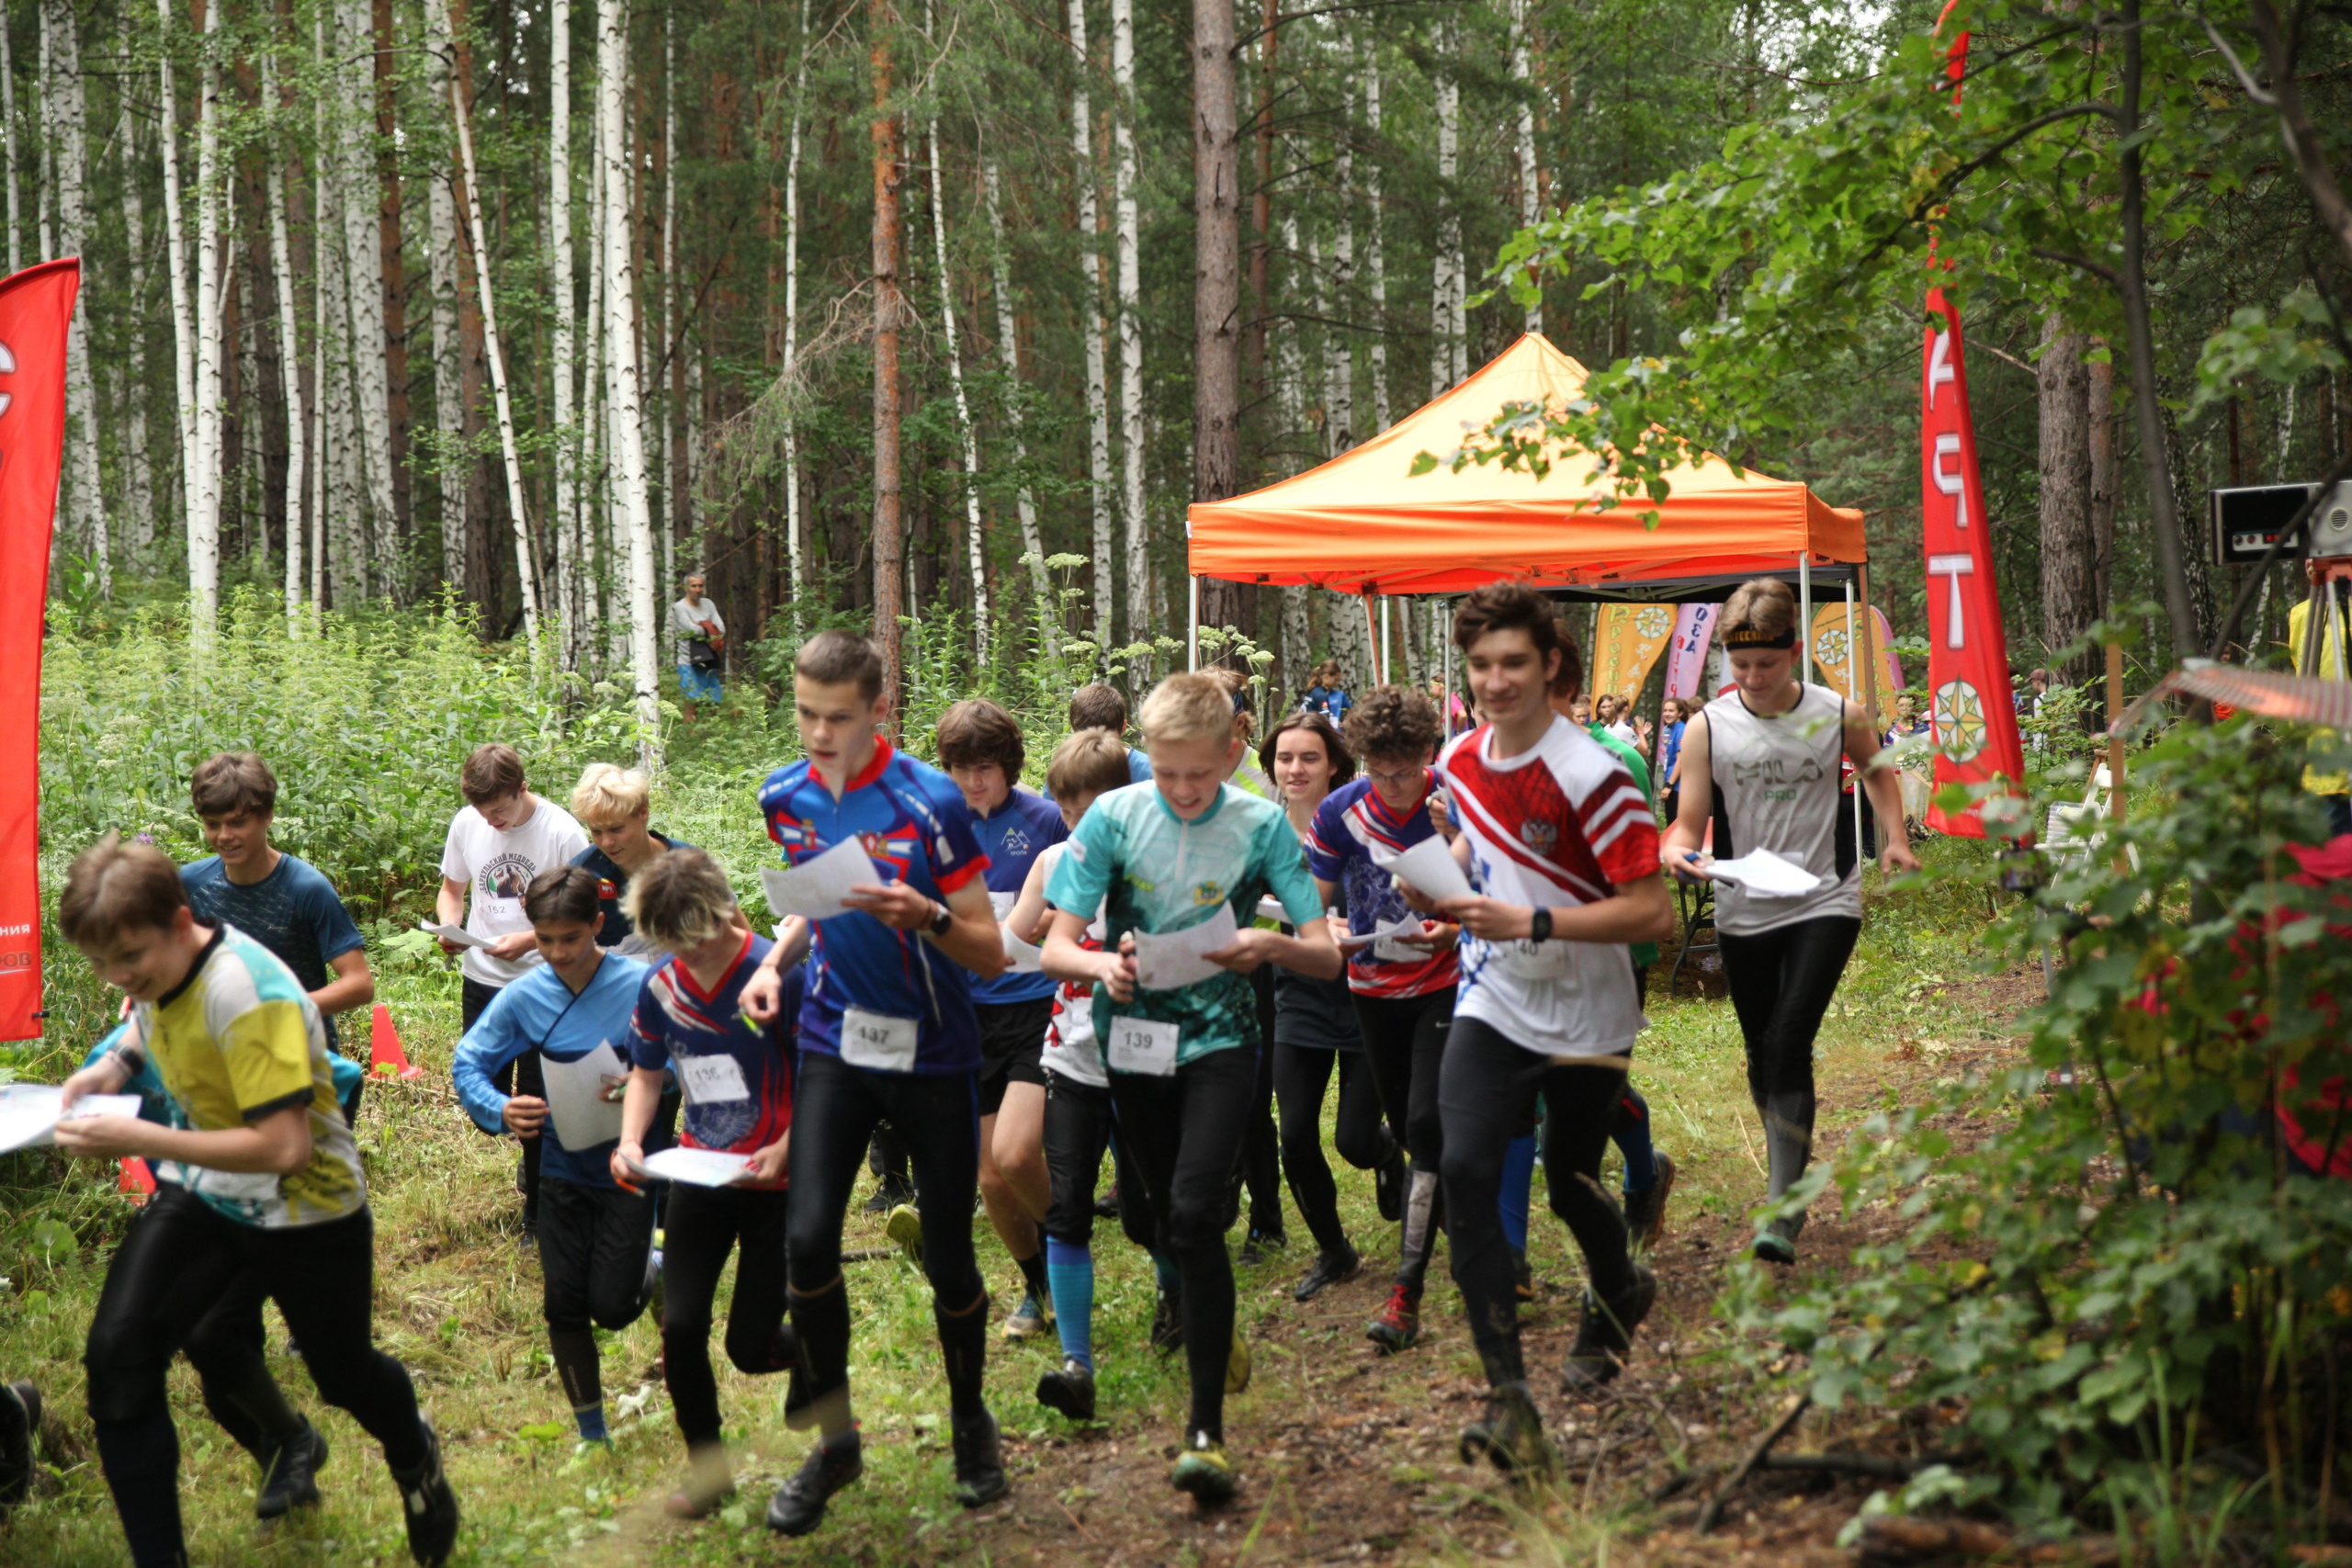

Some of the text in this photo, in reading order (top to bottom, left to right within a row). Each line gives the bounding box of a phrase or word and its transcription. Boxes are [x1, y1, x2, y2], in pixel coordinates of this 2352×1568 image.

[1733, 758, 1824, 786] FILA
[1764, 789, 1796, 802] PRO
[479, 852, 537, 894] БАРКУЛЬСКИЙ МЕДВЕДЬ
[488, 905, 506, 914] 152
[0, 952, 32, 968] ОВ
[860, 1025, 889, 1043] 137
[1125, 1031, 1153, 1049] 139
